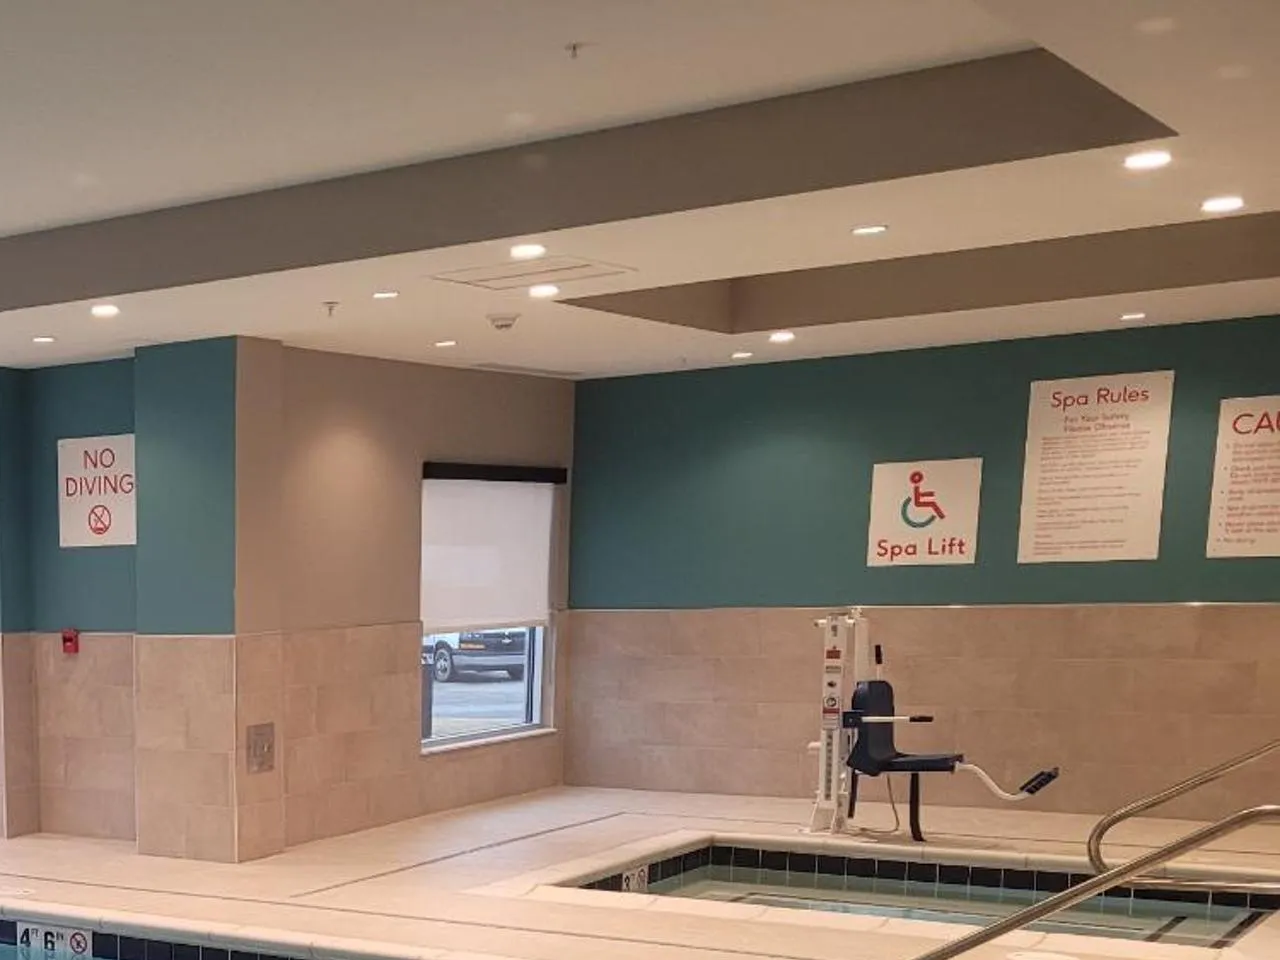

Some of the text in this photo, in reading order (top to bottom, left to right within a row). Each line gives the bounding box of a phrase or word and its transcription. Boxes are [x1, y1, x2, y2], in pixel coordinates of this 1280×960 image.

[1051, 385, 1149, 412] Spa Rules
[83, 448, 115, 469] NO
[65, 474, 134, 497] DIVING
[877, 537, 965, 561] Spa Lift
